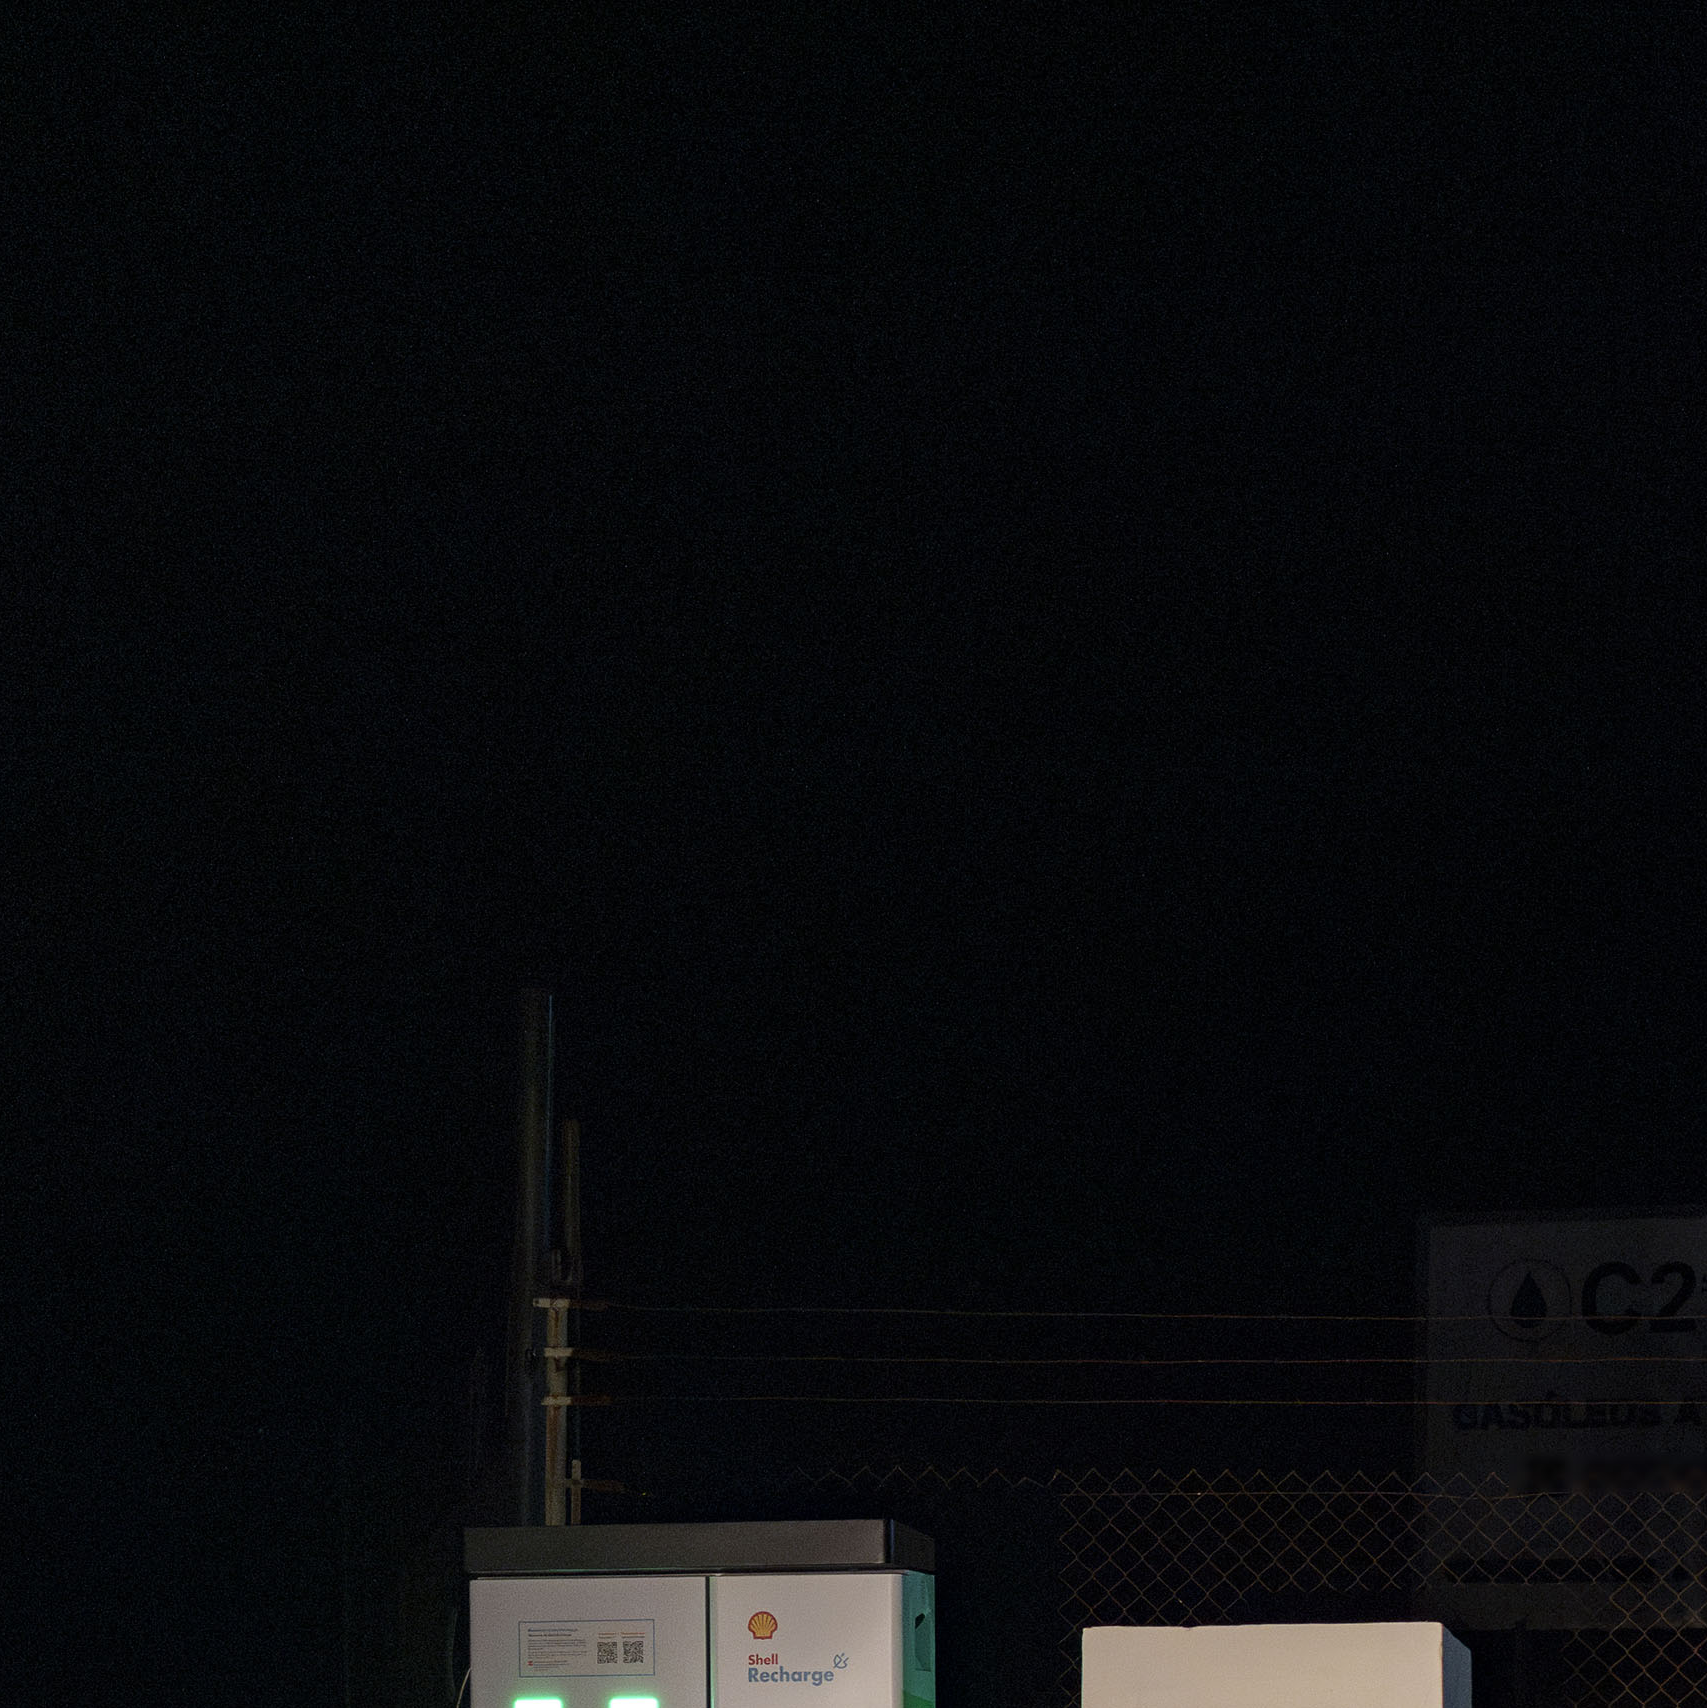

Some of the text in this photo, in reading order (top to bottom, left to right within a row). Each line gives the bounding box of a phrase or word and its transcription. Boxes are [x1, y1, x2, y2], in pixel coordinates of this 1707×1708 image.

[1582, 1261, 1697, 1336] C2
[748, 1653, 779, 1666] Shell
[748, 1666, 835, 1687] Recharge
